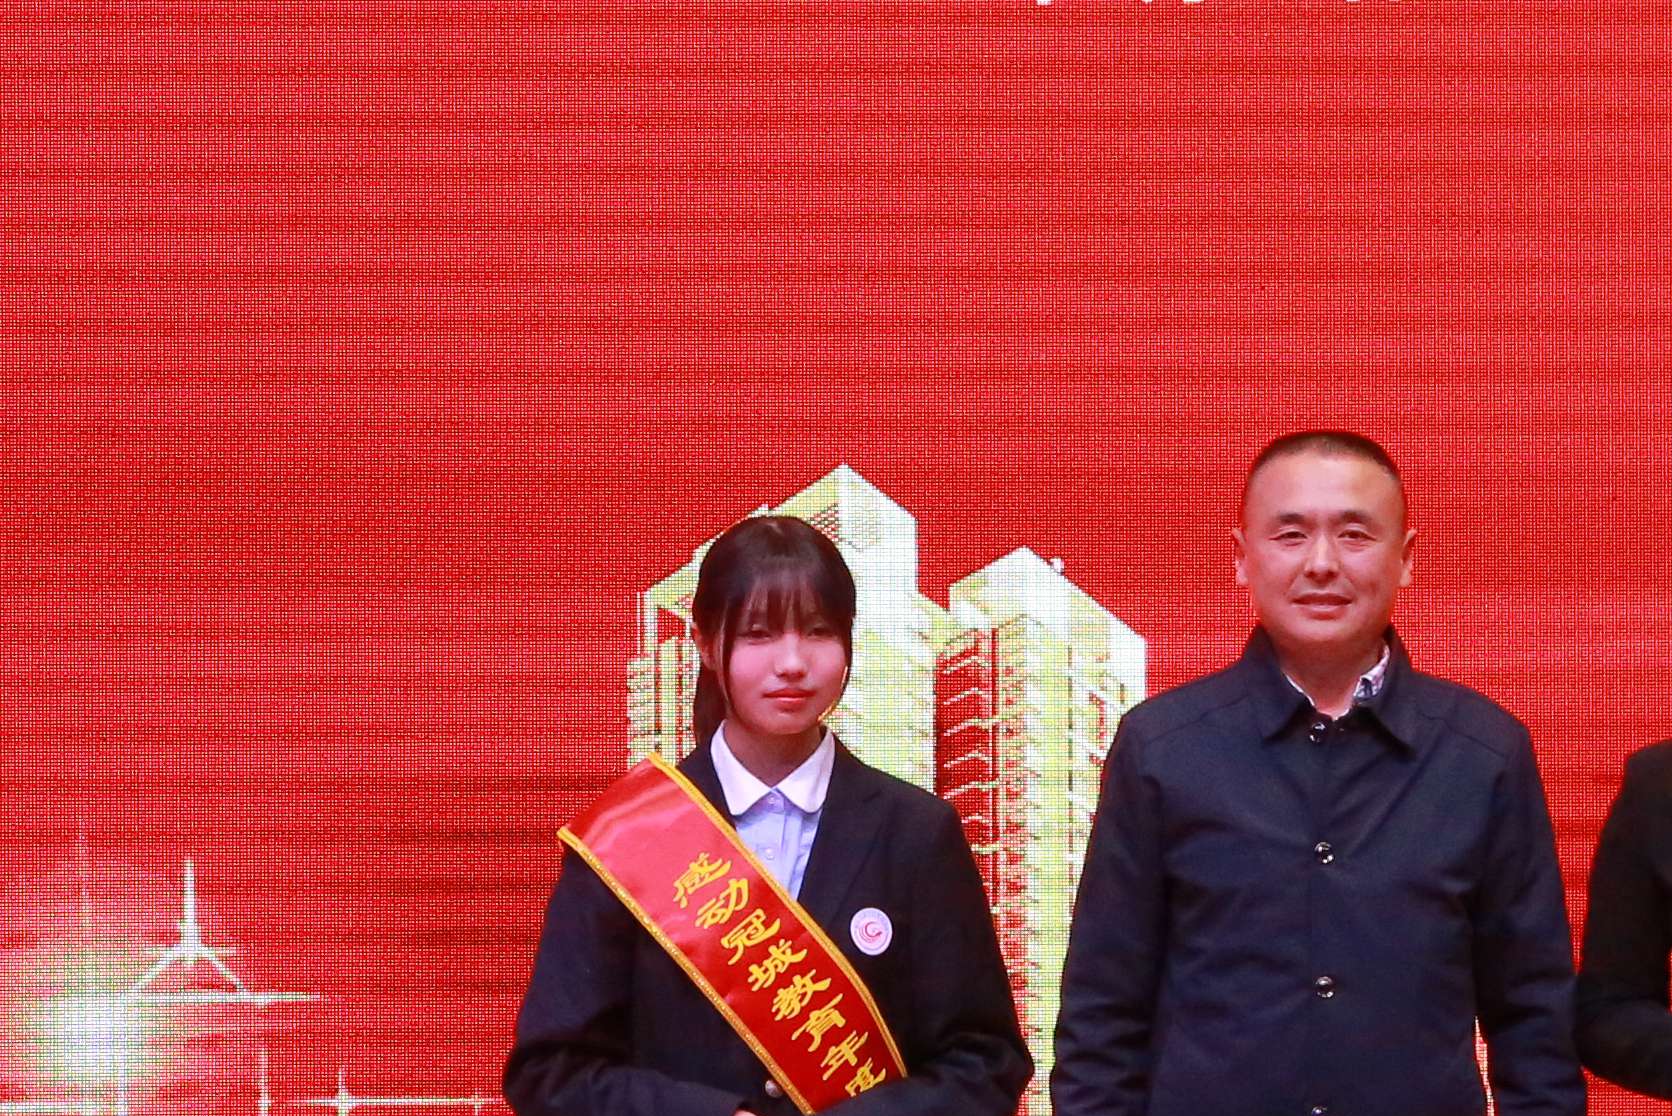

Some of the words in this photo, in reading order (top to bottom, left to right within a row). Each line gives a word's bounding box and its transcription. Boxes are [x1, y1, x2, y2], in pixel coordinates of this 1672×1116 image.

[672, 852, 887, 1098] 感动冠城教育年度
